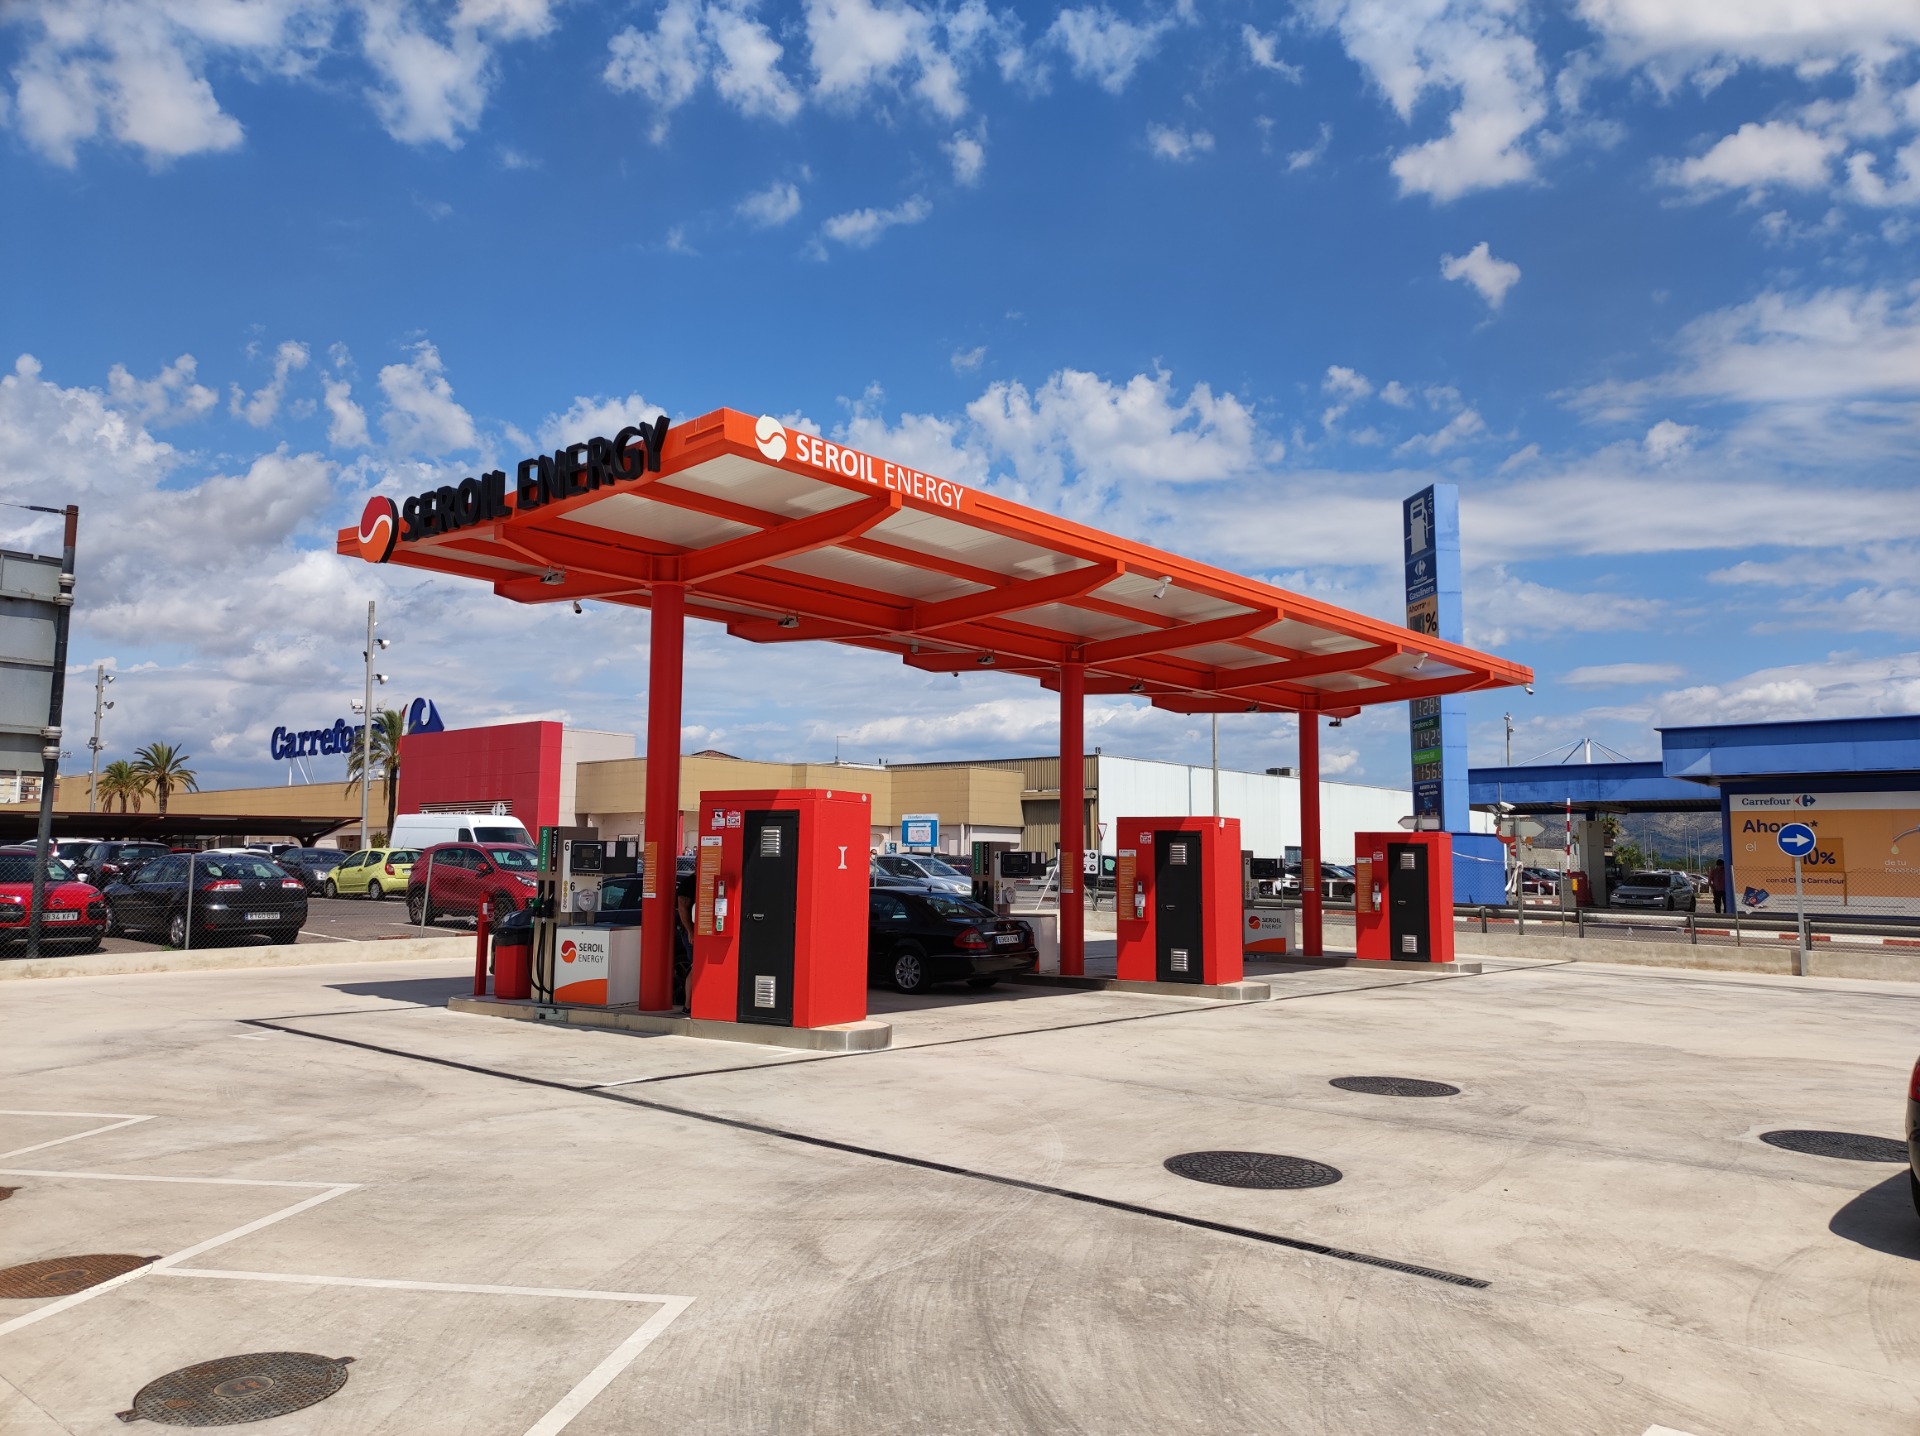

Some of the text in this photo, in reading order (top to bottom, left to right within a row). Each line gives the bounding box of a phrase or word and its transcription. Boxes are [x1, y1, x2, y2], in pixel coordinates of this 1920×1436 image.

[796, 435, 964, 510] SEROIL ENERGY
[401, 415, 671, 542] SEROIL ENERGY
[1409, 585, 1435, 601] Gasolinera
[1741, 797, 1791, 806] Carrefour
[564, 841, 570, 851] 6
[1745, 841, 1757, 852] el
[995, 852, 1000, 860] 4
[570, 881, 602, 892] 6 5
[1807, 877, 1844, 885] Carrefour
[578, 942, 604, 953] SEROIL
[578, 954, 604, 964] ENERGY
